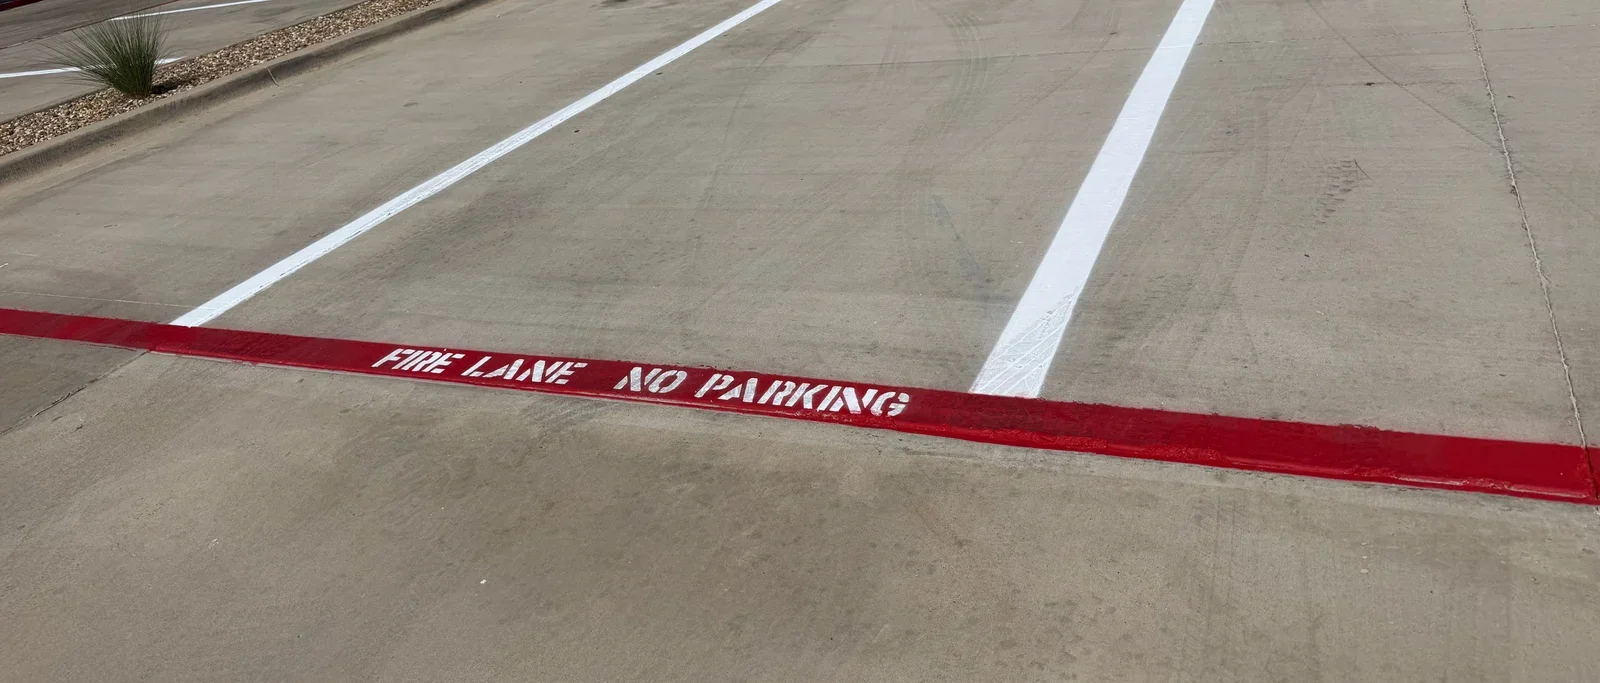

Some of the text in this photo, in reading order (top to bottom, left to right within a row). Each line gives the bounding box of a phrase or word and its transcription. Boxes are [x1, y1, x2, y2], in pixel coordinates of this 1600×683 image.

[372, 348, 910, 417] FIRE LANE NO PARKING
